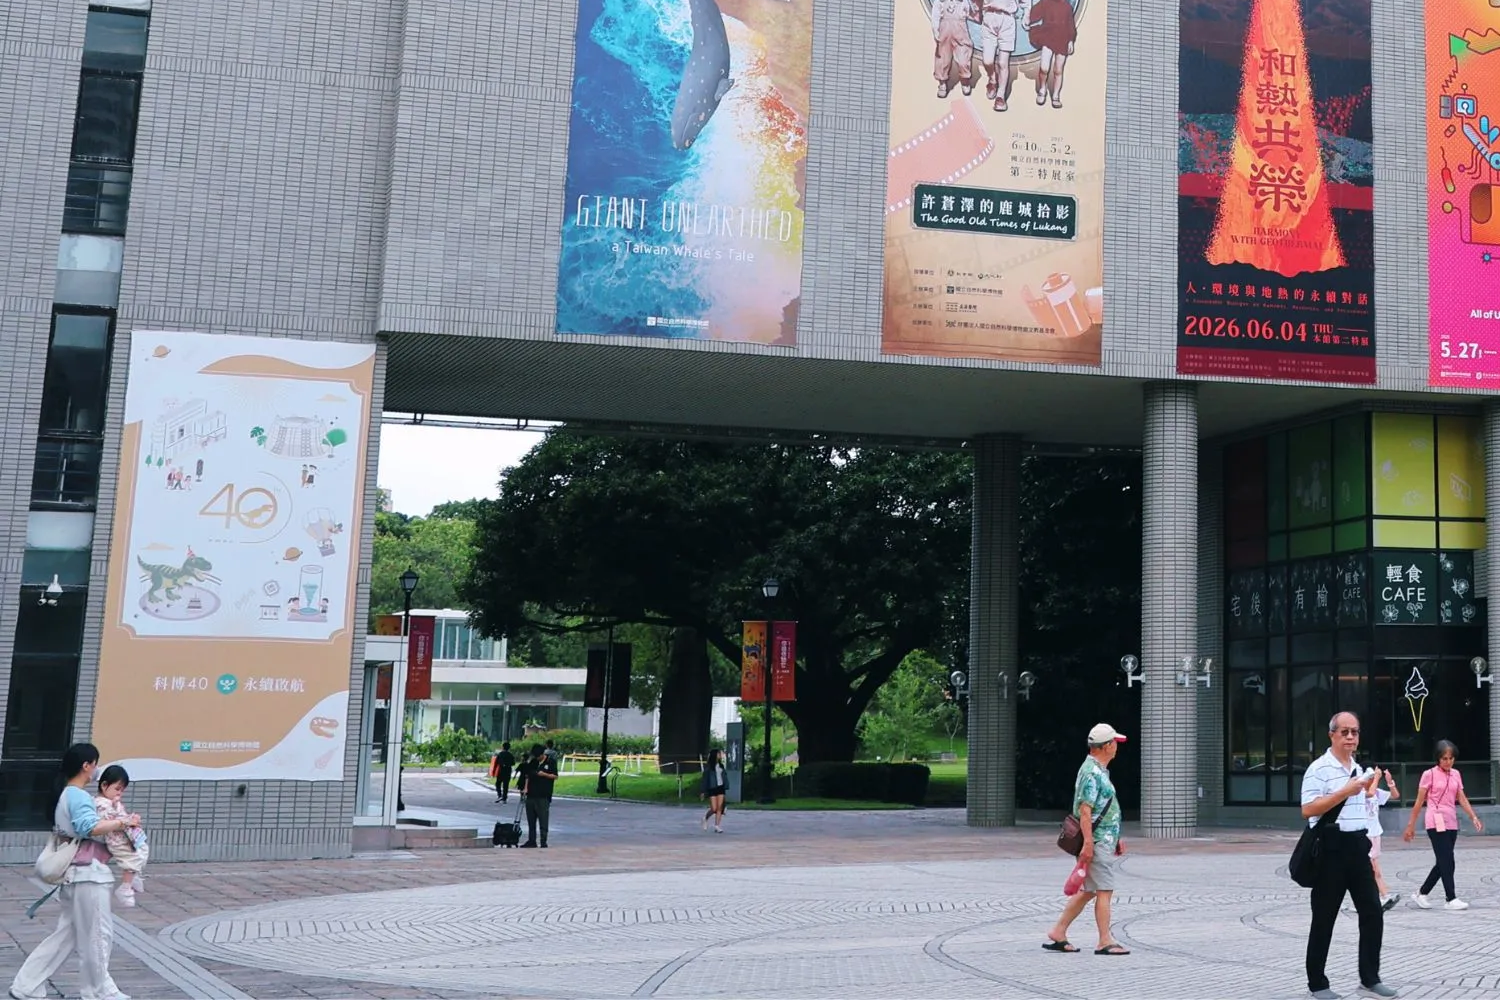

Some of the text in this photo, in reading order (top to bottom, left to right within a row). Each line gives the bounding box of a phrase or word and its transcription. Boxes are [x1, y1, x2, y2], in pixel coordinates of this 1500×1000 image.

[1248, 47, 1308, 214] 和熱共榮
[921, 193, 1070, 220] 許蒼澤的鹿城拾影
[576, 194, 793, 242] GIANT UNEARTHED
[920, 213, 1068, 234] The Good Old Times of Lukang
[1230, 234, 1256, 245] WITH
[611, 240, 755, 262] a Taiwan Whale's Tale
[1470, 309, 1483, 319] All
[1483, 310, 1495, 319] of
[1184, 315, 1308, 342] 2026.06.04
[1312, 323, 1334, 334] THU
[1385, 563, 1423, 584] 輕食
[1342, 586, 1361, 600] CAFE
[1381, 586, 1426, 602] CAFE
[153, 676, 209, 692] 科博40
